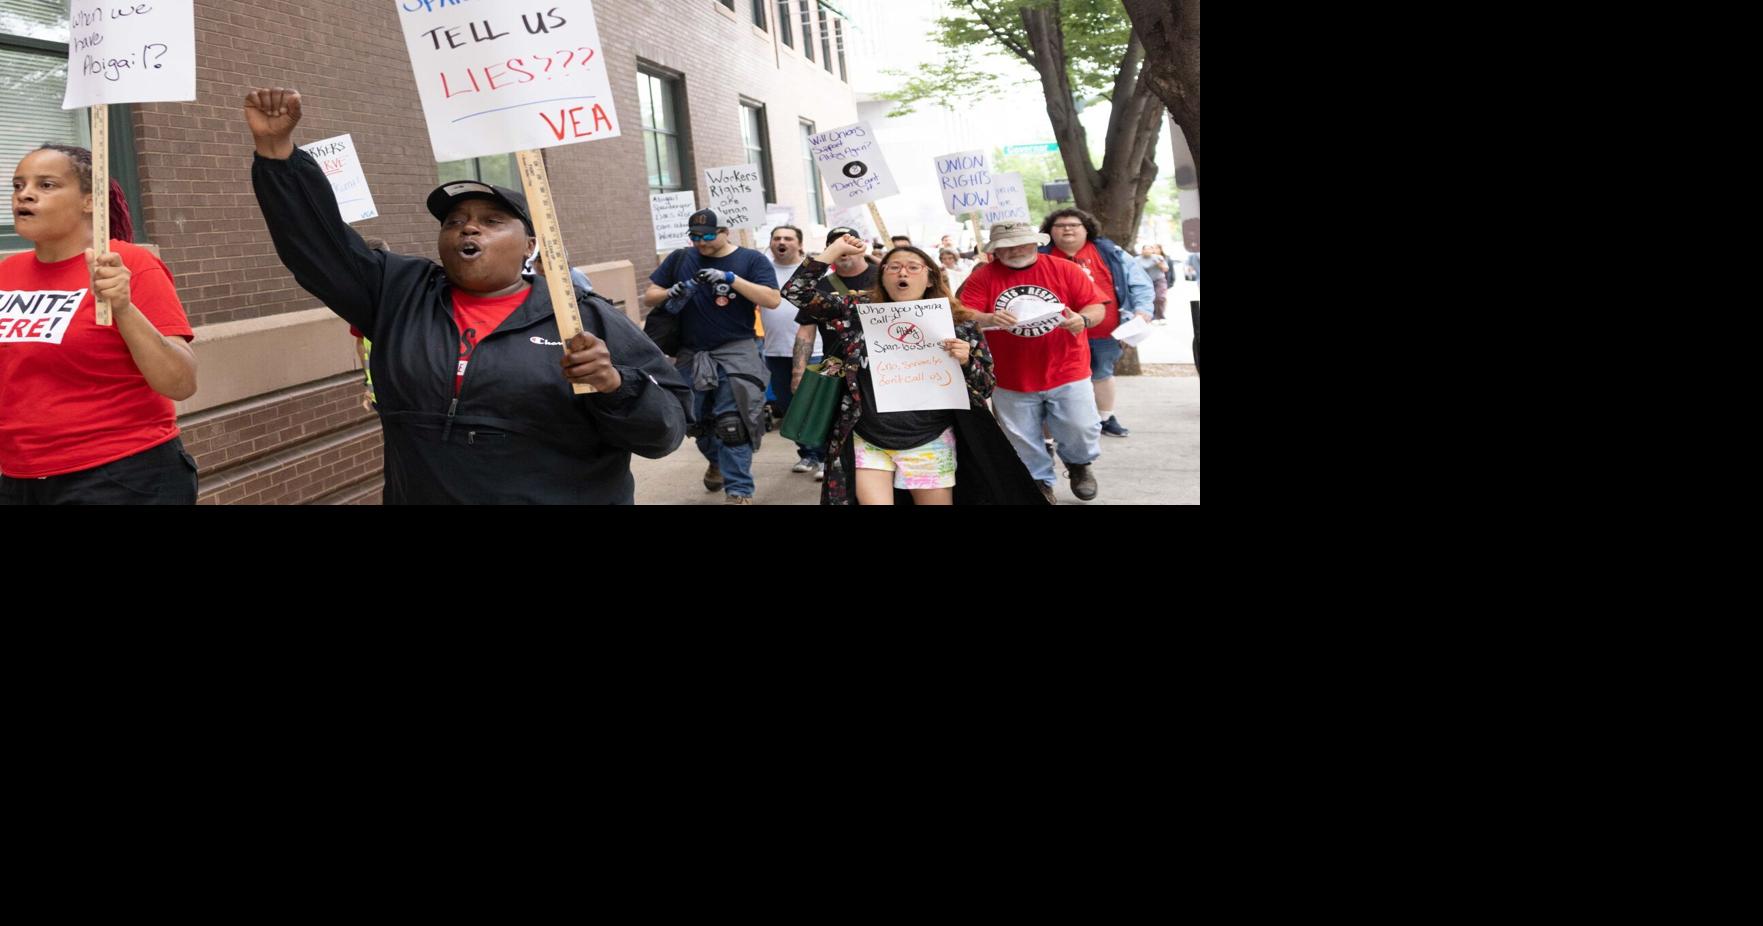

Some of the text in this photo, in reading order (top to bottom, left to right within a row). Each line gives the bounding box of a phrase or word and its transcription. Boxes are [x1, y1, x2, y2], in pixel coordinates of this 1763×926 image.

[111, 4, 152, 19] we
[421, 7, 567, 50] TELL US
[74, 31, 103, 52] have
[83, 43, 168, 81] Abigail?
[440, 47, 595, 98] LIES???
[539, 103, 613, 141] VEA
[307, 141, 346, 158] RKERS
[937, 155, 984, 175] UNION
[706, 169, 758, 183] Workers
[941, 171, 992, 190] RIGHTS
[710, 183, 752, 200] Rights
[951, 190, 989, 210] NOW
[726, 214, 749, 227] ghts
[985, 207, 1026, 222] UNIONS
[0, 292, 81, 314] UNITÉ
[994, 288, 1020, 309] IGHTS
[859, 304, 886, 315] Who
[891, 305, 912, 320] you
[0, 317, 63, 339] ERE!
